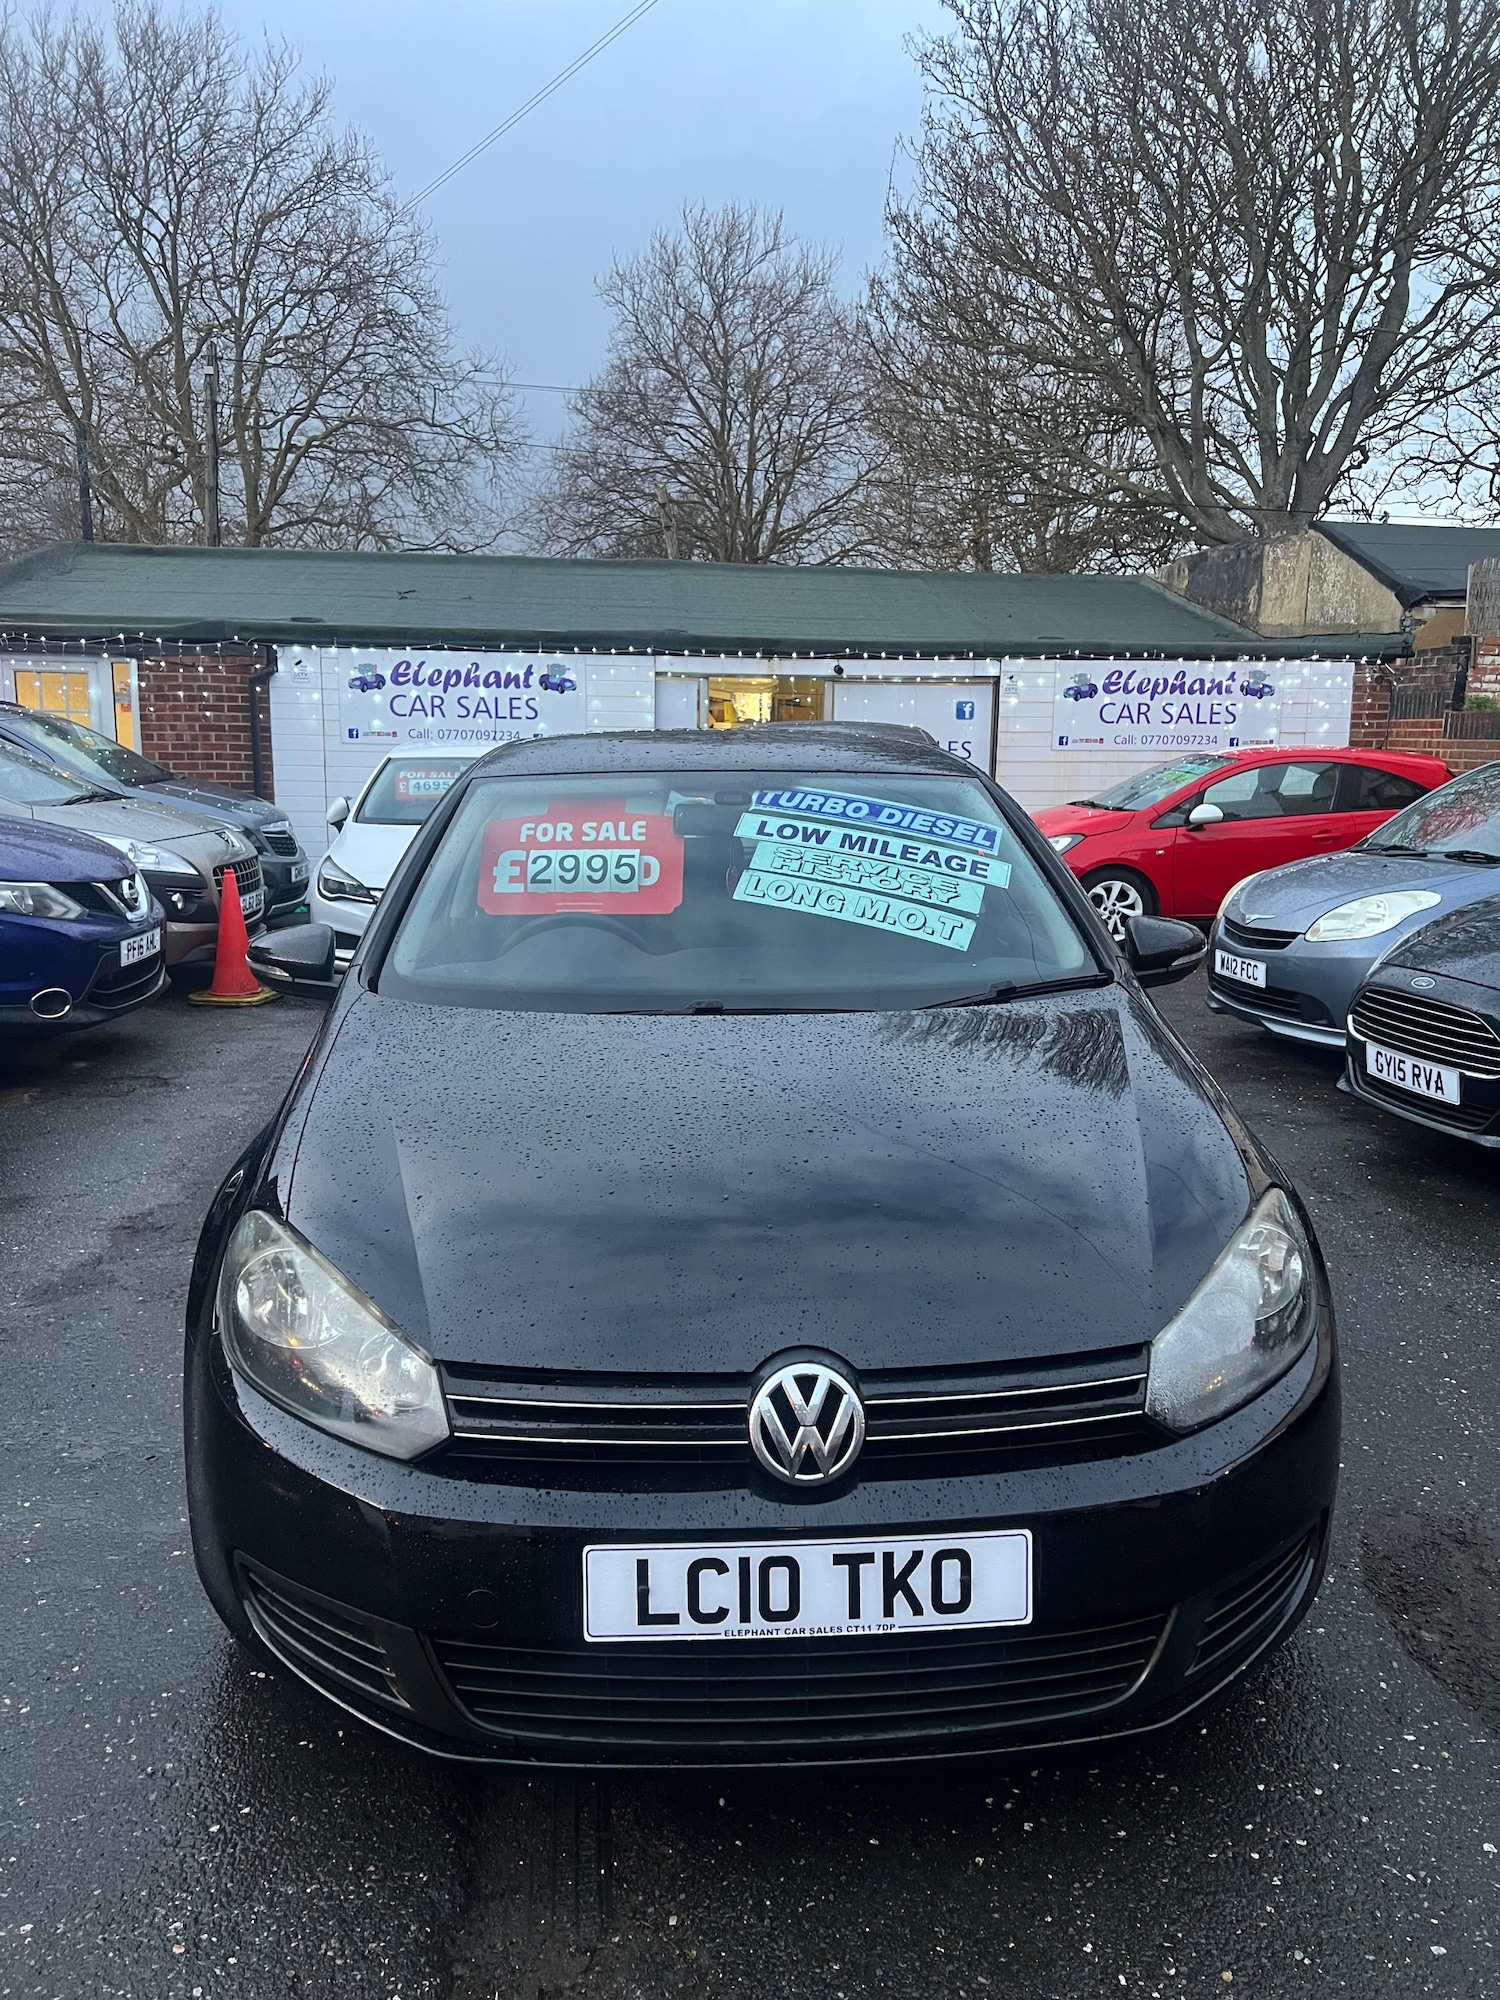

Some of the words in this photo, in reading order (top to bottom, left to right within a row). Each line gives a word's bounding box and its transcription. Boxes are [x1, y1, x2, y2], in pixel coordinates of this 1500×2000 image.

[390, 660, 534, 693] Elephant
[1102, 669, 1237, 701] Elephant
[390, 694, 446, 719] CAR
[456, 696, 539, 721] SALES
[1099, 703, 1151, 725] CAR
[1161, 703, 1237, 725] SALES
[408, 728, 434, 740] Call:
[437, 729, 521, 741] 07707097234
[1113, 734, 1137, 746] Call:
[1141, 734, 1218, 746] 07707097234
[399, 771, 425, 779] FOR
[429, 771, 461, 779] SALE
[519, 823, 574, 843] FOR
[582, 821, 647, 842] SALE
[760, 790, 871, 819] TURBO
[879, 807, 995, 847] DIESEL
[756, 820, 831, 845] LOW
[839, 833, 990, 879] MILEAGE
[770, 856, 961, 904] HISTORY
[773, 845, 961, 892] SERVICE
[744, 875, 847, 913] LONG
[853, 895, 965, 942] M.O.T
[126, 937, 144, 961] PF16
[1220, 953, 1238, 976] WA12
[1240, 960, 1259, 982] FCC
[1375, 1050, 1406, 1083] GY15
[1412, 1062, 1445, 1096] RVA
[636, 1555, 801, 1627] LC10
[832, 1548, 972, 1620] TKO
[724, 1628, 781, 1637] ELEPHANT
[784, 1627, 806, 1636] CAR
[809, 1626, 843, 1635] SALES
[846, 1625, 872, 1633] CT11
[876, 1623, 896, 1631] 7DP
